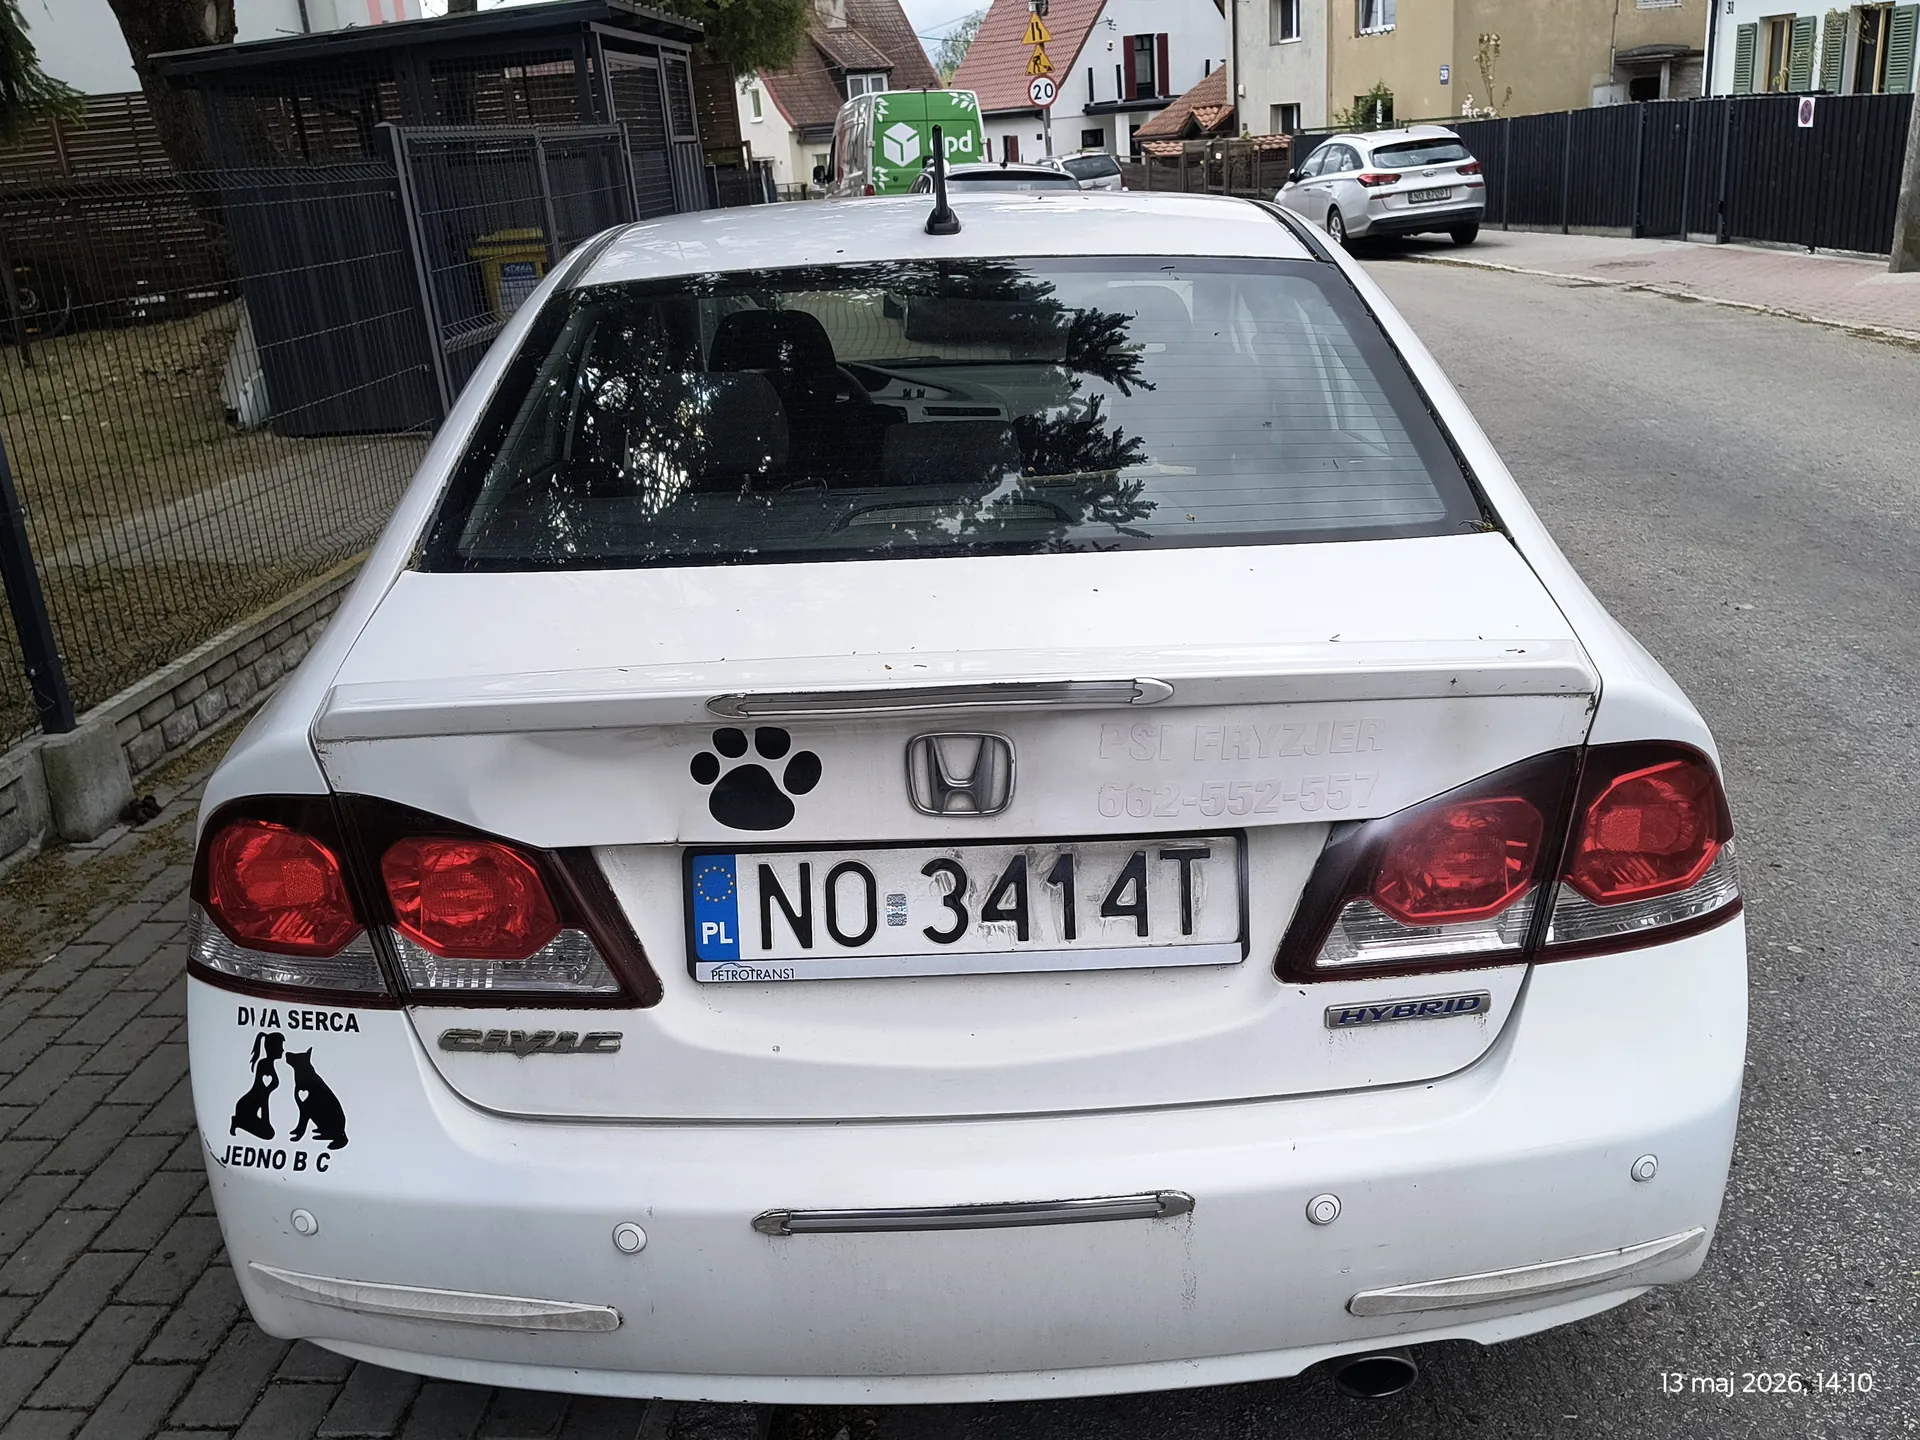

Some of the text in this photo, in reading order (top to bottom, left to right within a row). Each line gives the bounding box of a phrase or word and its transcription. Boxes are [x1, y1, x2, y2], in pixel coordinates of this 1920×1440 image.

[1033, 83, 1053, 100] 20
[1099, 717, 1386, 761] PSI FRYZJER
[1098, 772, 1379, 818] 662-552-557
[758, 848, 1211, 951] NO 3414T
[702, 921, 733, 944] PL
[711, 968, 795, 981] PETROTRANS1
[287, 1010, 360, 1033] SERCA
[1337, 996, 1481, 1026] HYBRID
[438, 1028, 624, 1060] CIVIC
[221, 1145, 287, 1170] JEDNO
